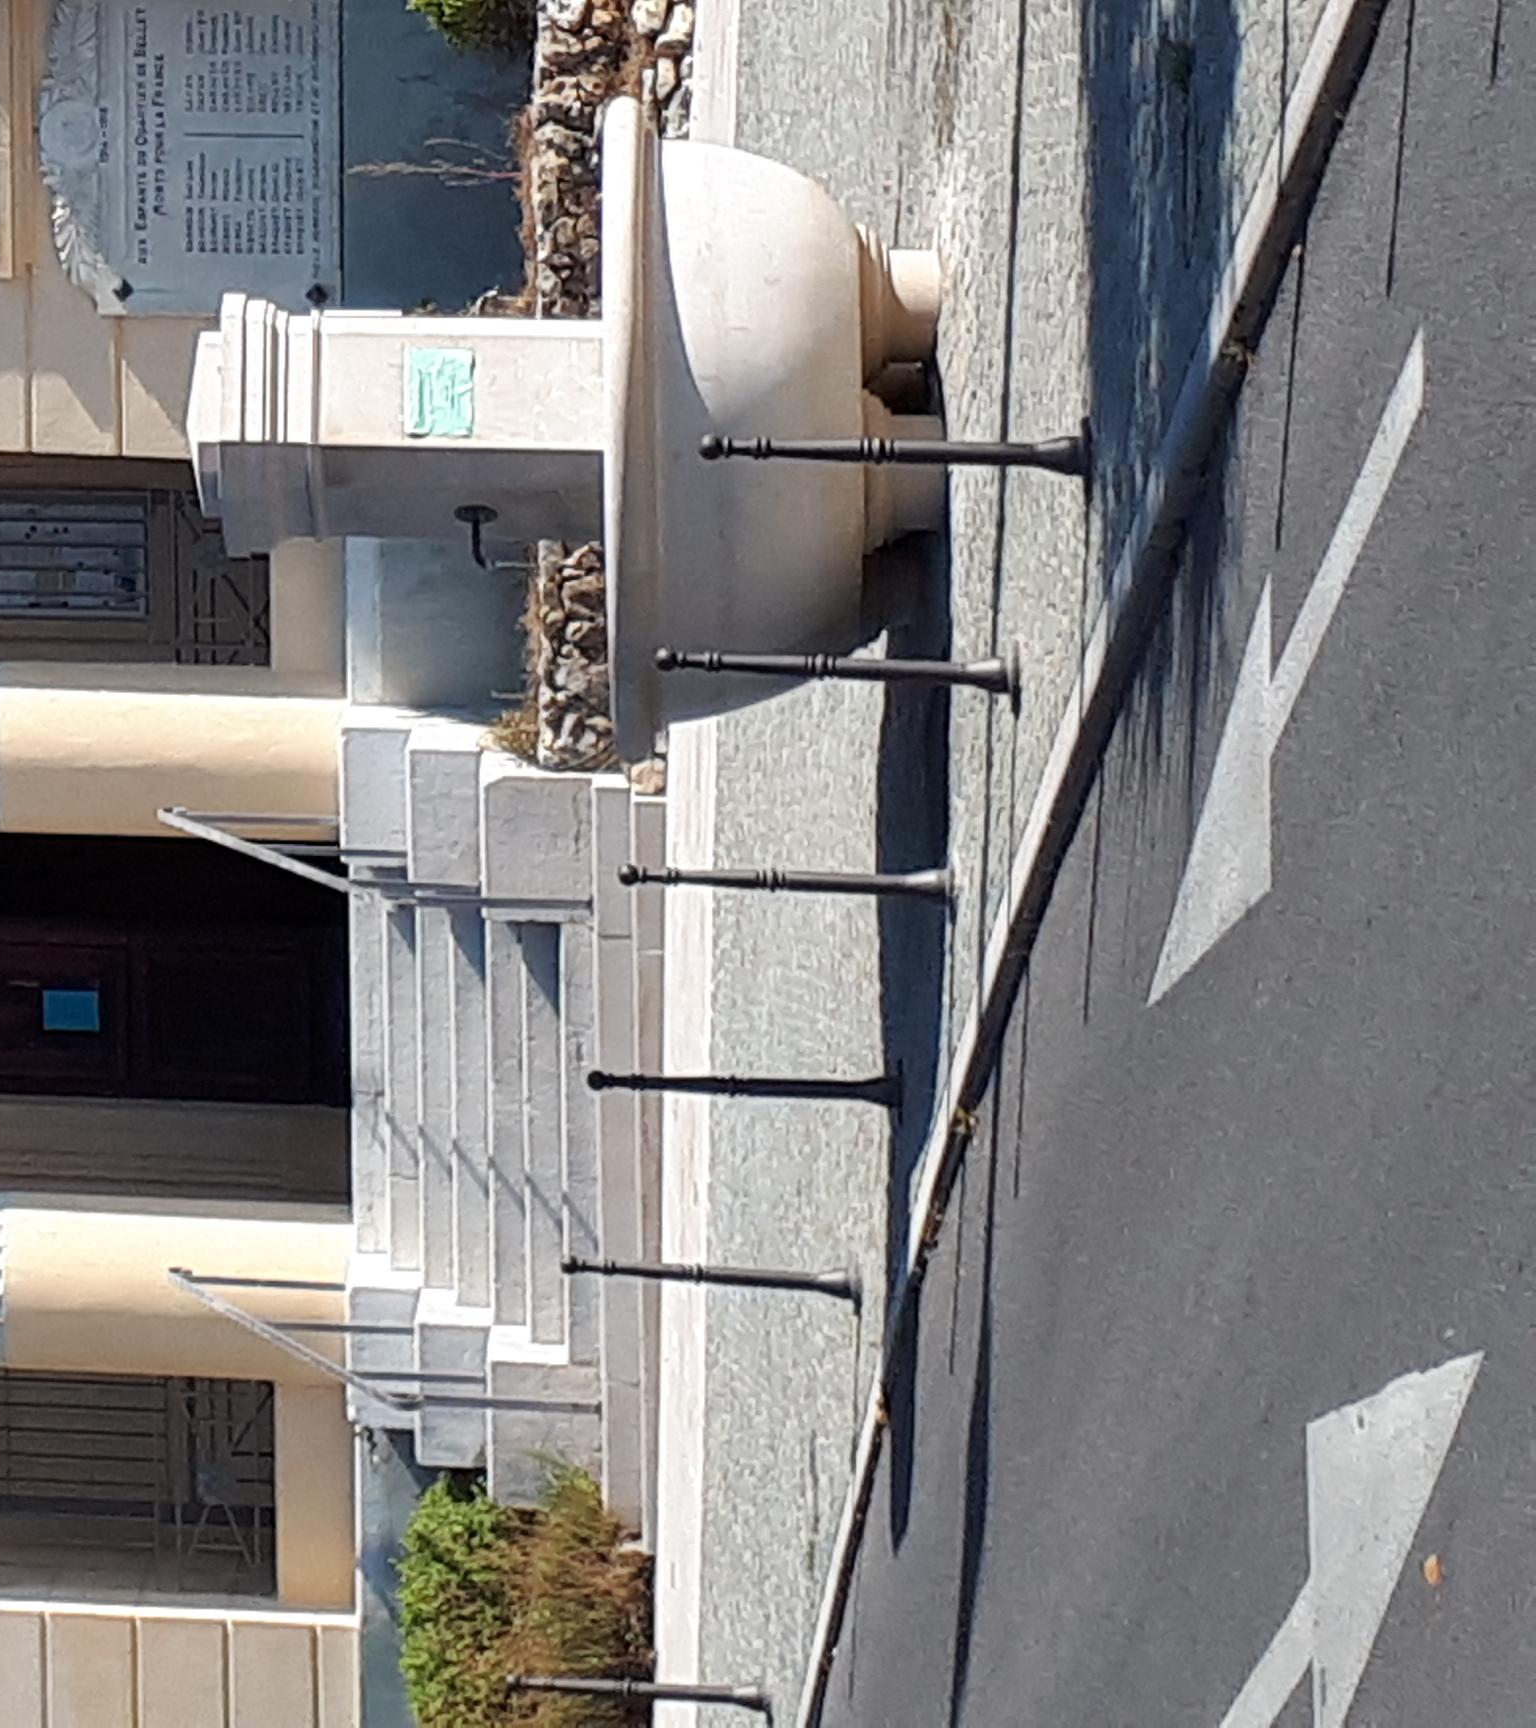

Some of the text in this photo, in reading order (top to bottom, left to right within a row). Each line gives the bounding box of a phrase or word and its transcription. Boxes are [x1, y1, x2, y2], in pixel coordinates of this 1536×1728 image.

[133, 8, 147, 58] BELLET
[134, 81, 148, 146] QUARTIER
[151, 53, 167, 216] MORTS POUR LA FRANCE
[134, 172, 147, 231] ENFANTS
[137, 239, 147, 264] AUX
